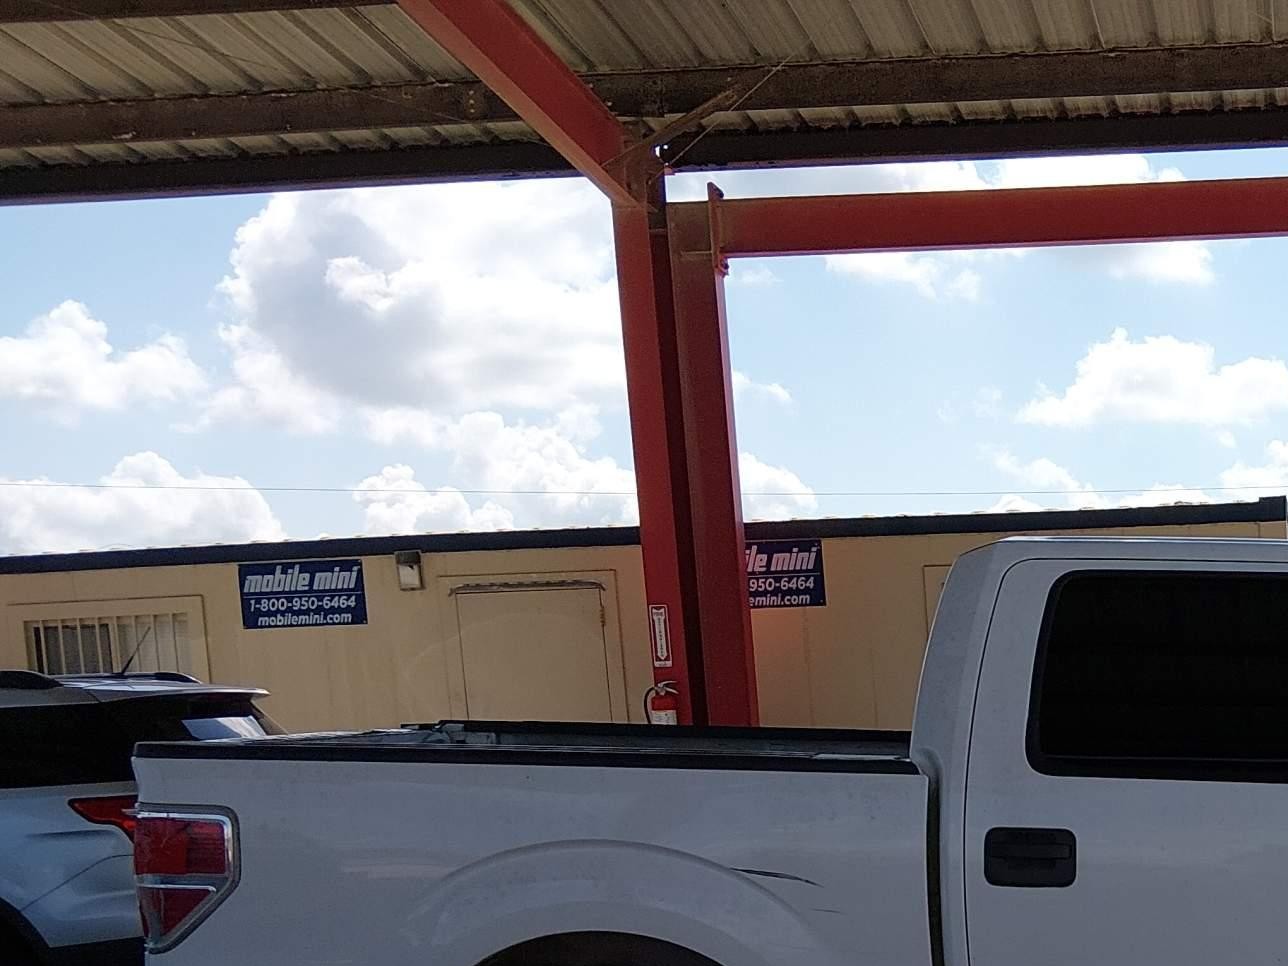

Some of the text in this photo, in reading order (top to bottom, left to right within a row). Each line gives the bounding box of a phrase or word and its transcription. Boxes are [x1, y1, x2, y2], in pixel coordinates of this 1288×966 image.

[770, 547, 817, 571] mini
[243, 564, 360, 593] mobile mini
[749, 576, 814, 592] 950-6464
[249, 595, 356, 612] 1-800-950-6464
[749, 594, 810, 607] emini.com
[257, 612, 352, 626] mobilemini.com
